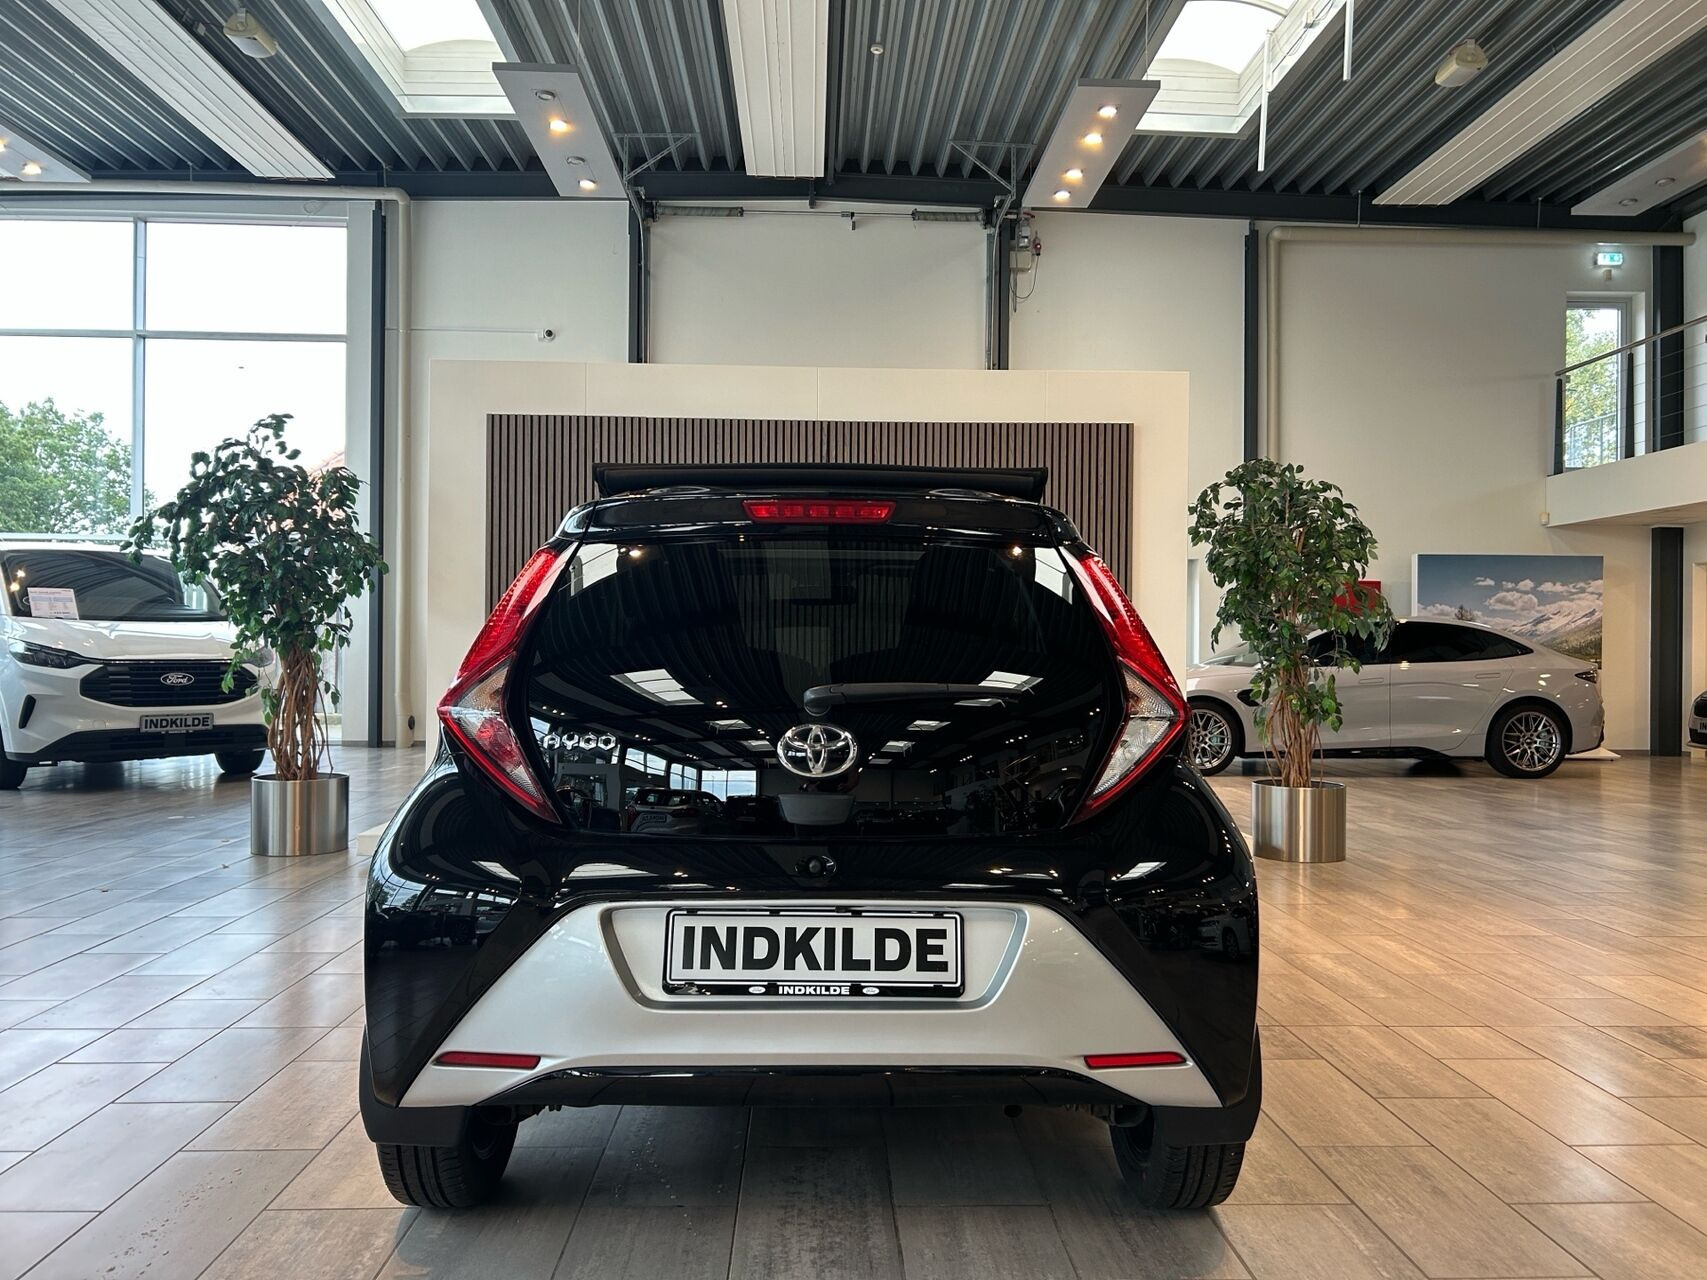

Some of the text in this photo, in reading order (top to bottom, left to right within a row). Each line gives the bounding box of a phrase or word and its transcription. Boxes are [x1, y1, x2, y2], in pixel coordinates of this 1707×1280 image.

[165, 673, 189, 685] Ford
[144, 716, 210, 729] INDKILDE
[543, 732, 616, 750] AYGO
[681, 925, 949, 972] INDKILDE
[778, 985, 850, 995] INDKILDE
